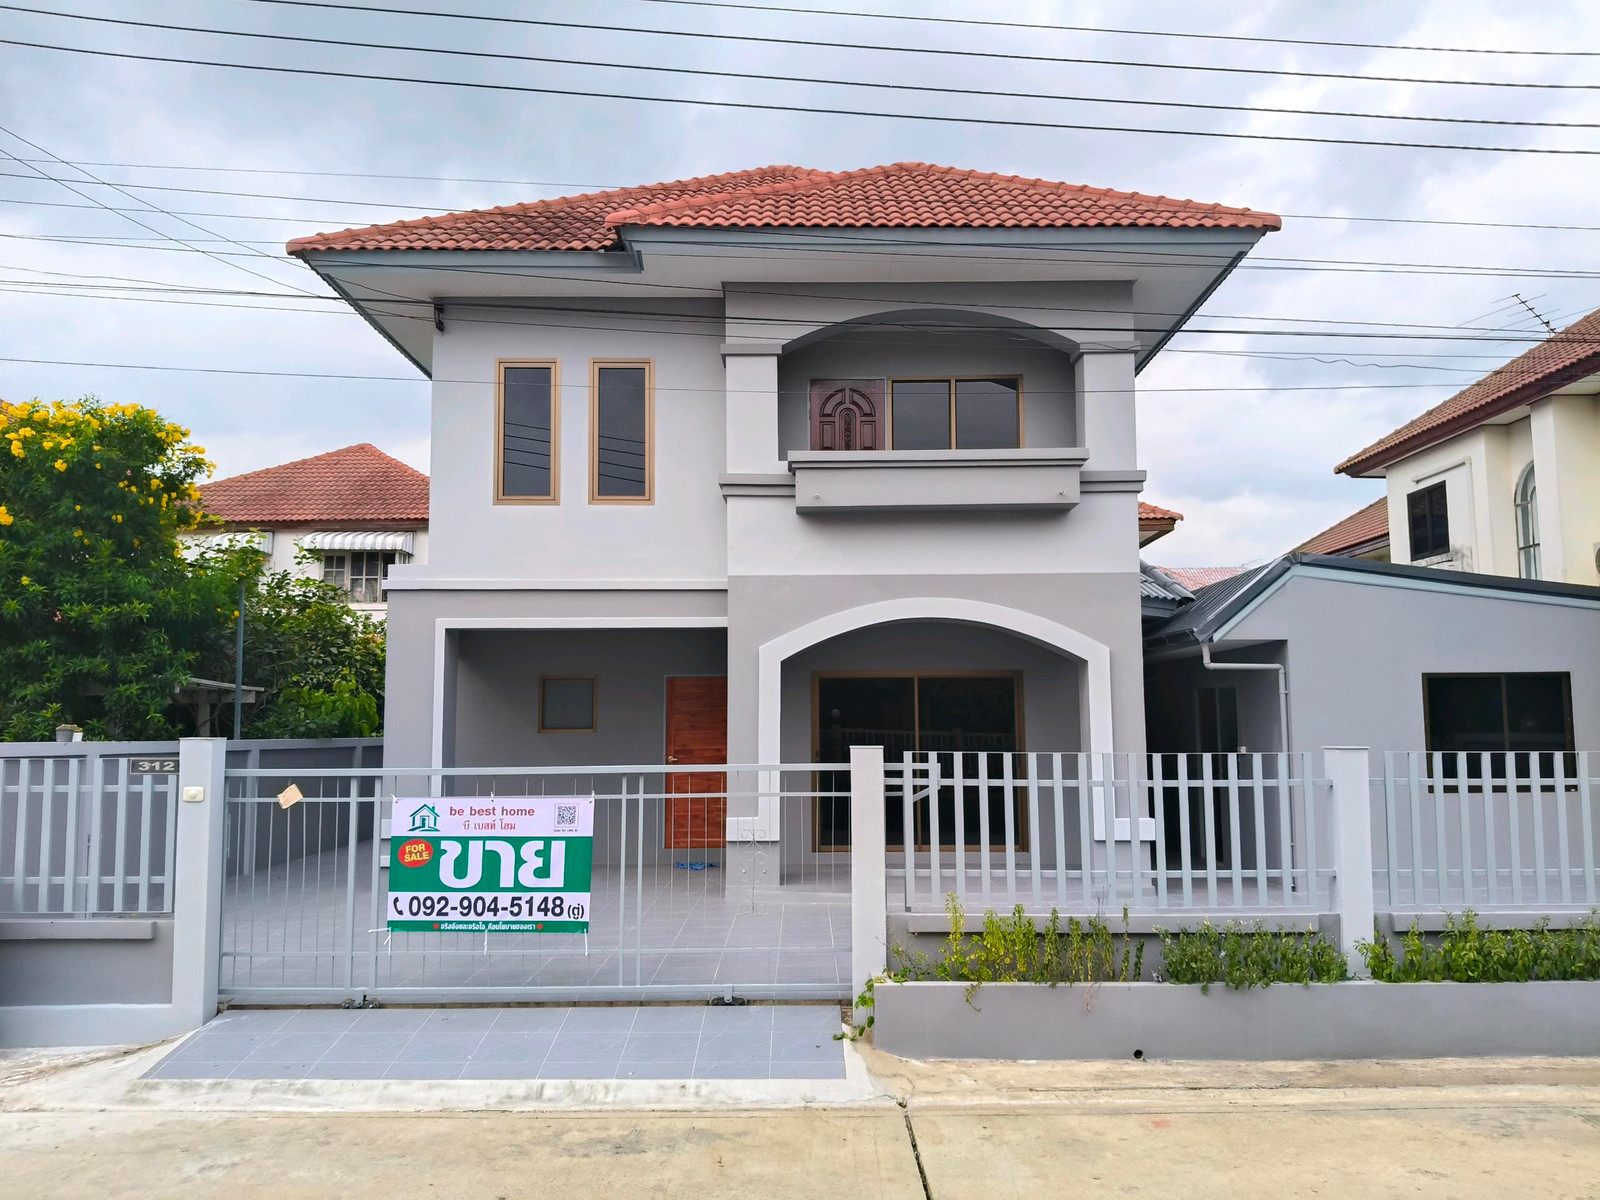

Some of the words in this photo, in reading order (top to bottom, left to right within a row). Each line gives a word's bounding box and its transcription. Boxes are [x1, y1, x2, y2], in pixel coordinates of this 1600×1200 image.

[138, 761, 175, 771] 312
[449, 806, 465, 817] be
[469, 806, 497, 817] best
[501, 805, 536, 817] home
[499, 819, 516, 831] โฮม
[405, 843, 426, 853] FOR
[404, 851, 430, 863] SALE
[438, 840, 567, 889] ขาย
[408, 895, 565, 918] 092-904-5148
